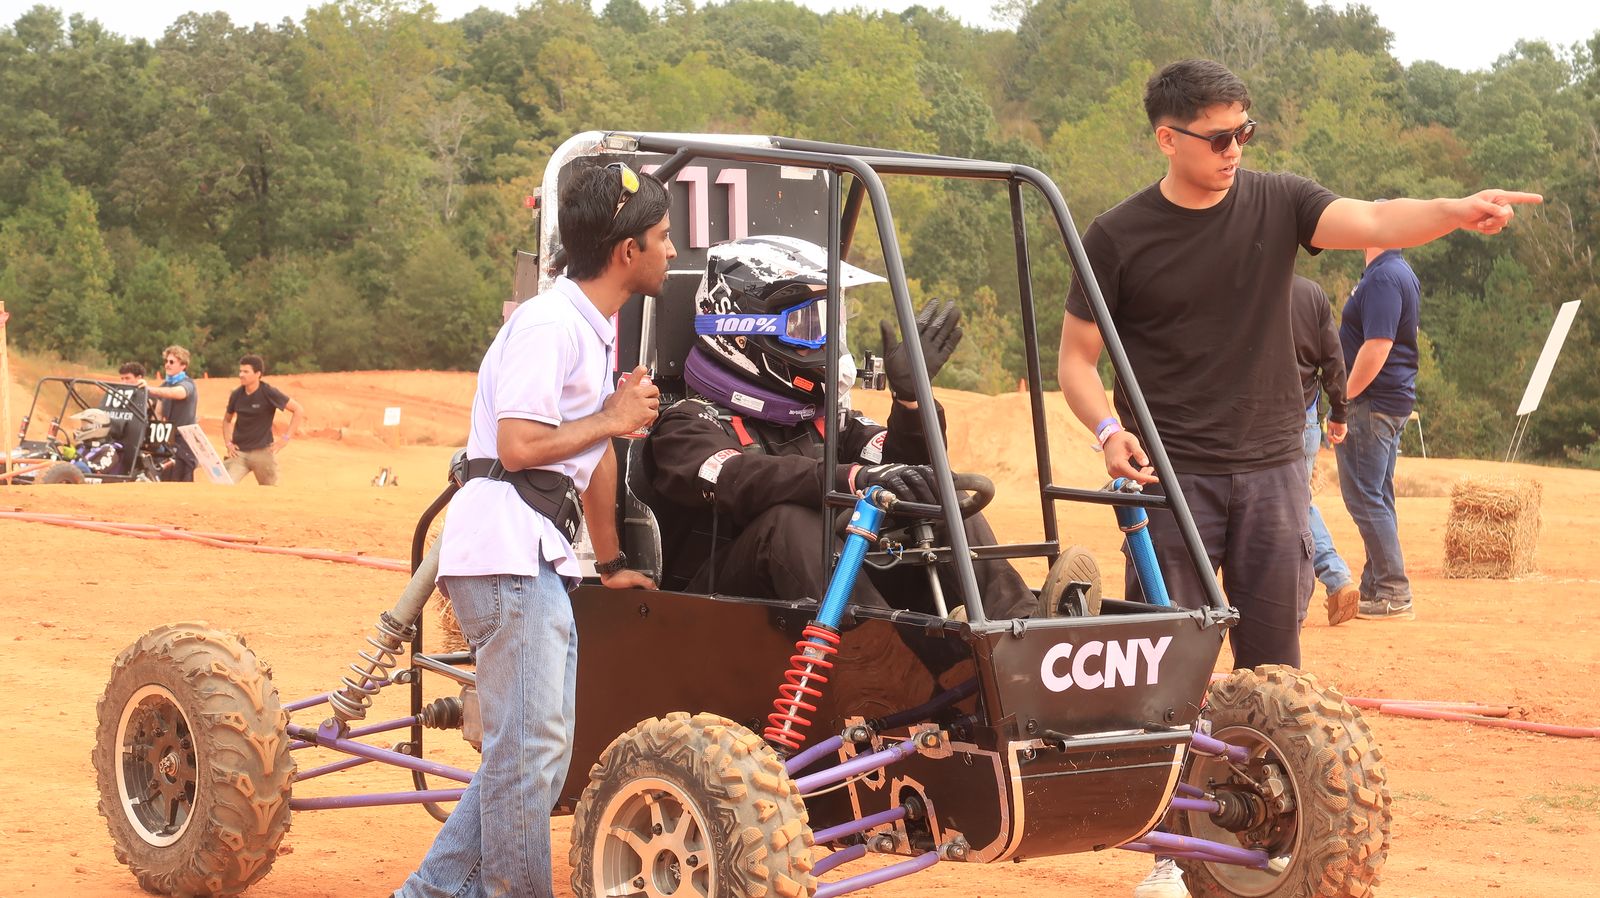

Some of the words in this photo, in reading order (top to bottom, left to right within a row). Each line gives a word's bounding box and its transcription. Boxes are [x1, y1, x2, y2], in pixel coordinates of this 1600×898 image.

[640, 164, 749, 249] 11
[715, 317, 778, 333] 100%
[105, 389, 134, 409] 107
[150, 423, 173, 443] 107
[1040, 635, 1174, 693] CCNY
